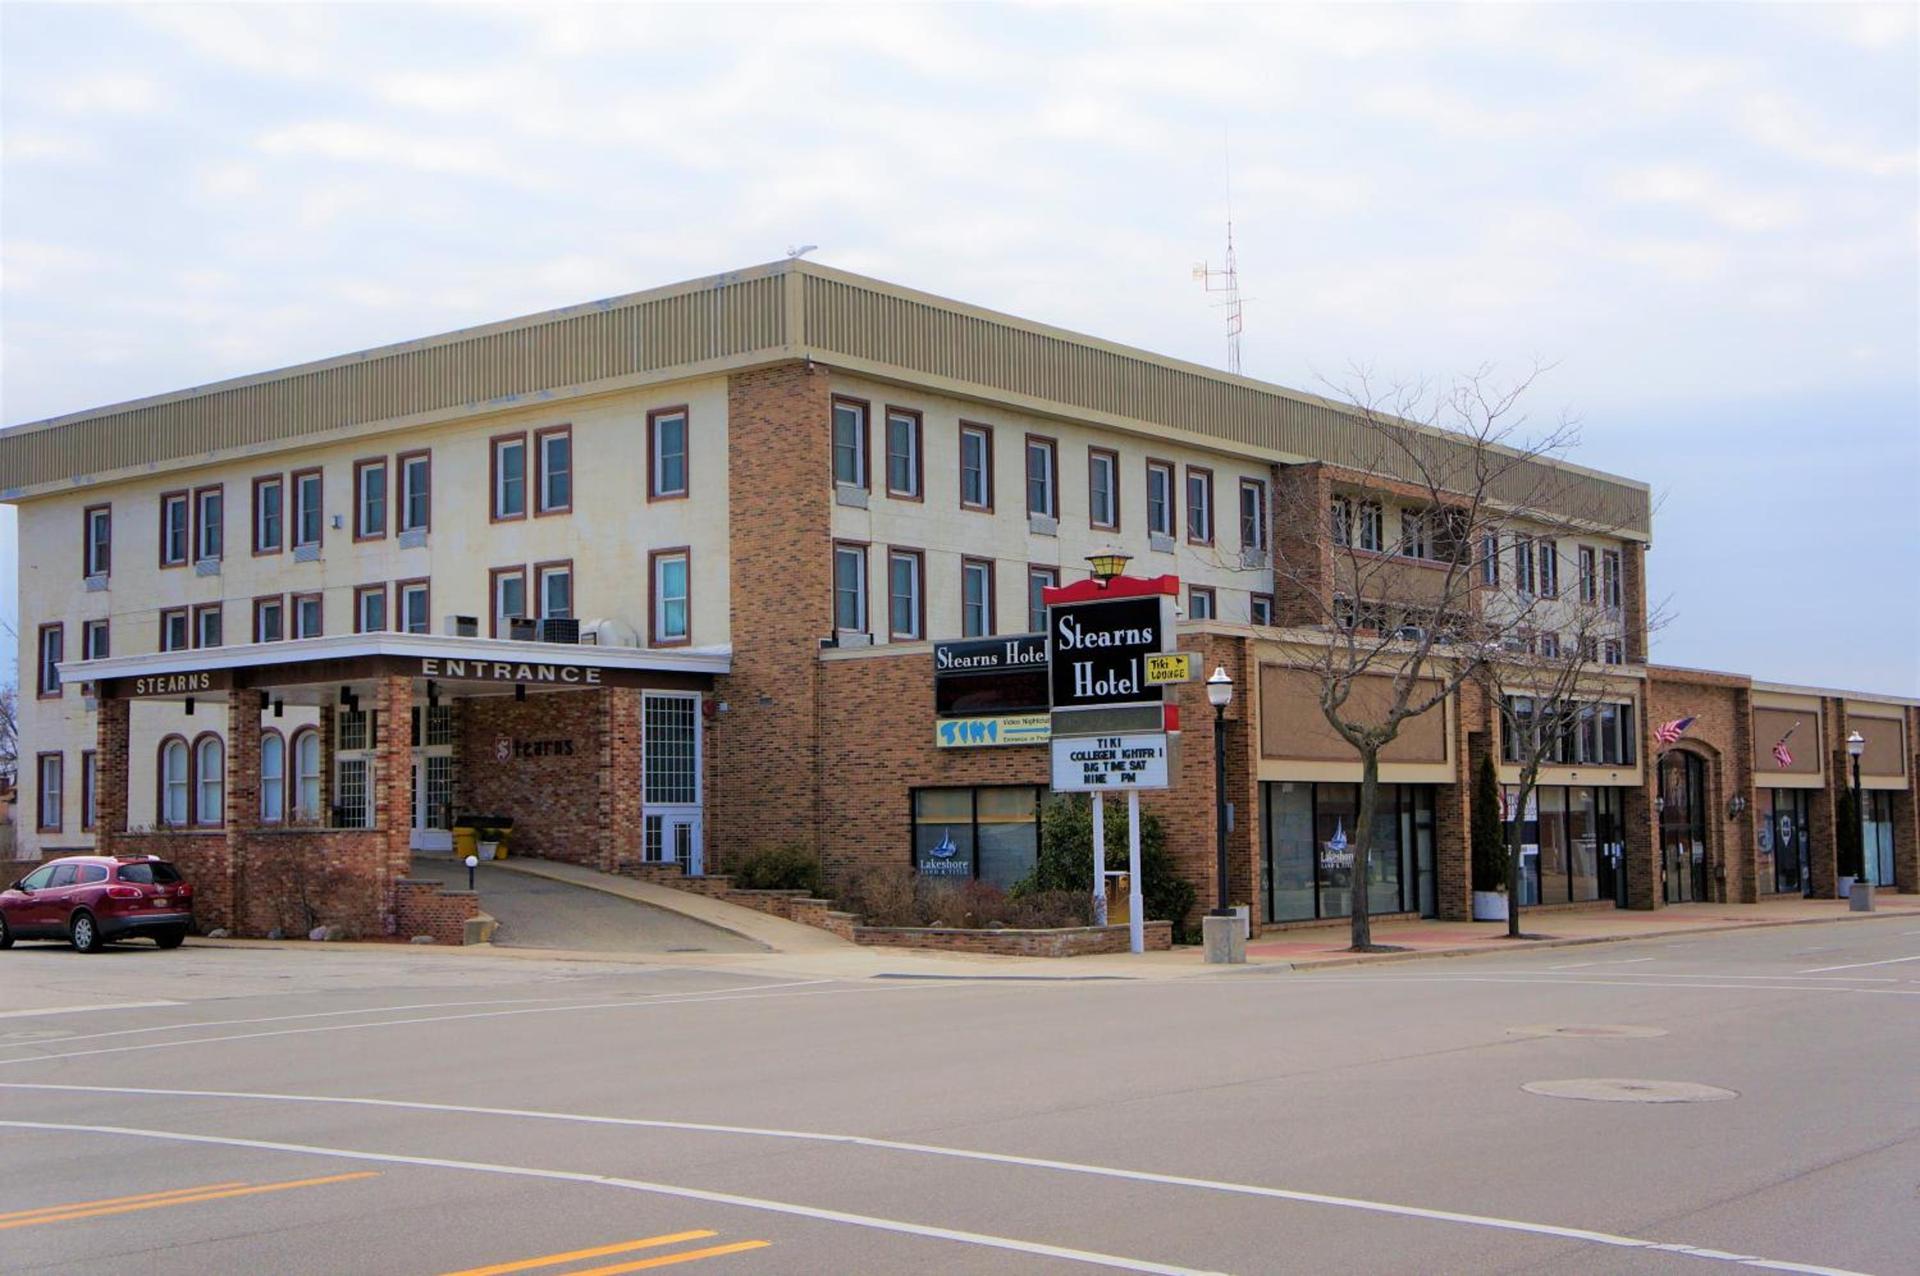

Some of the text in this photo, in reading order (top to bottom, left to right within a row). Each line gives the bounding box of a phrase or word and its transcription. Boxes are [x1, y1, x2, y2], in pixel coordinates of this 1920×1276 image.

[1059, 614, 1153, 651] Stearns
[937, 640, 1049, 669] Stearns Hotel
[422, 658, 602, 683] ENTRANCE
[1072, 658, 1140, 697] Hotel
[1151, 669, 1185, 680] LOUNGE
[136, 673, 210, 694] STEARNS
[1096, 738, 1121, 748] TIKI
[1083, 762, 1099, 772] BIG
[1129, 760, 1147, 771] SAT
[1083, 772, 1137, 784] NINE PM
[920, 858, 969, 869] Lakeshore
